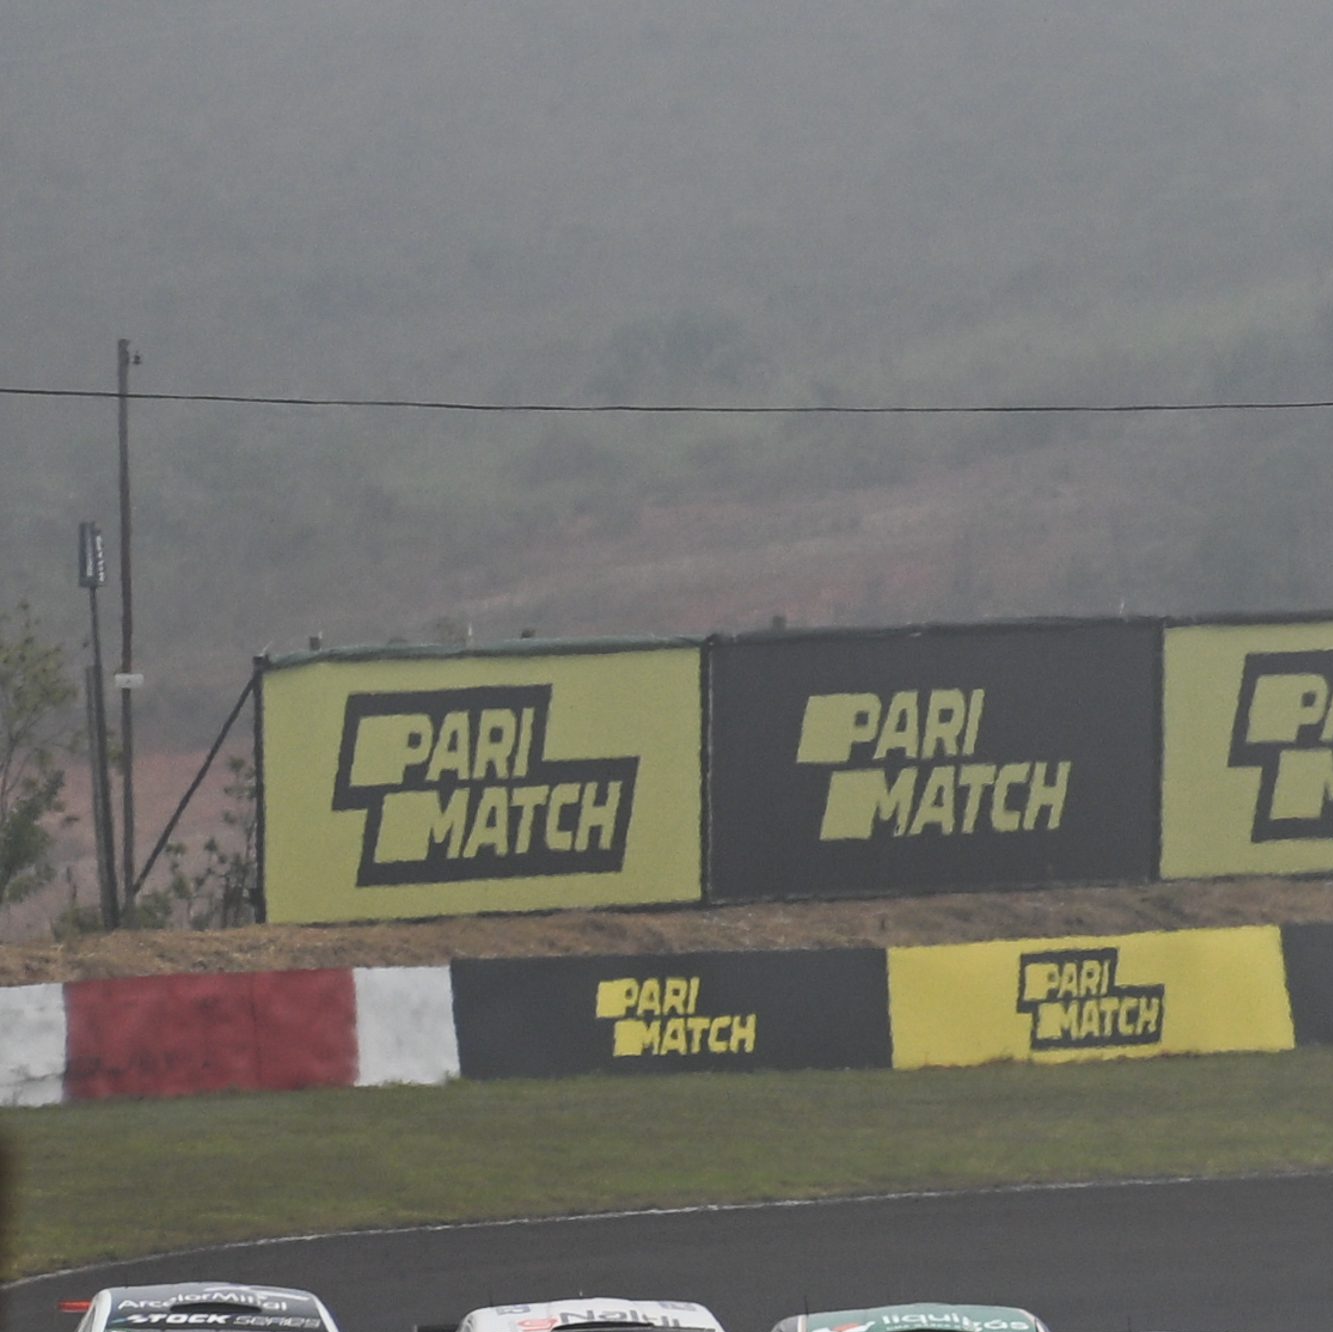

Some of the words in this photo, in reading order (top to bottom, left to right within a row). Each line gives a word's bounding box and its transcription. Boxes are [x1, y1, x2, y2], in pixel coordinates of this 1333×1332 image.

[349, 708, 534, 787] PARI
[797, 689, 984, 763] PARI
[373, 780, 621, 864] MATCH
[820, 762, 1071, 841] MATCH
[596, 976, 700, 1019] PARI
[1024, 959, 1111, 1000] PARI
[614, 1014, 756, 1056] MATCH
[1037, 997, 1159, 1041] MATCH
